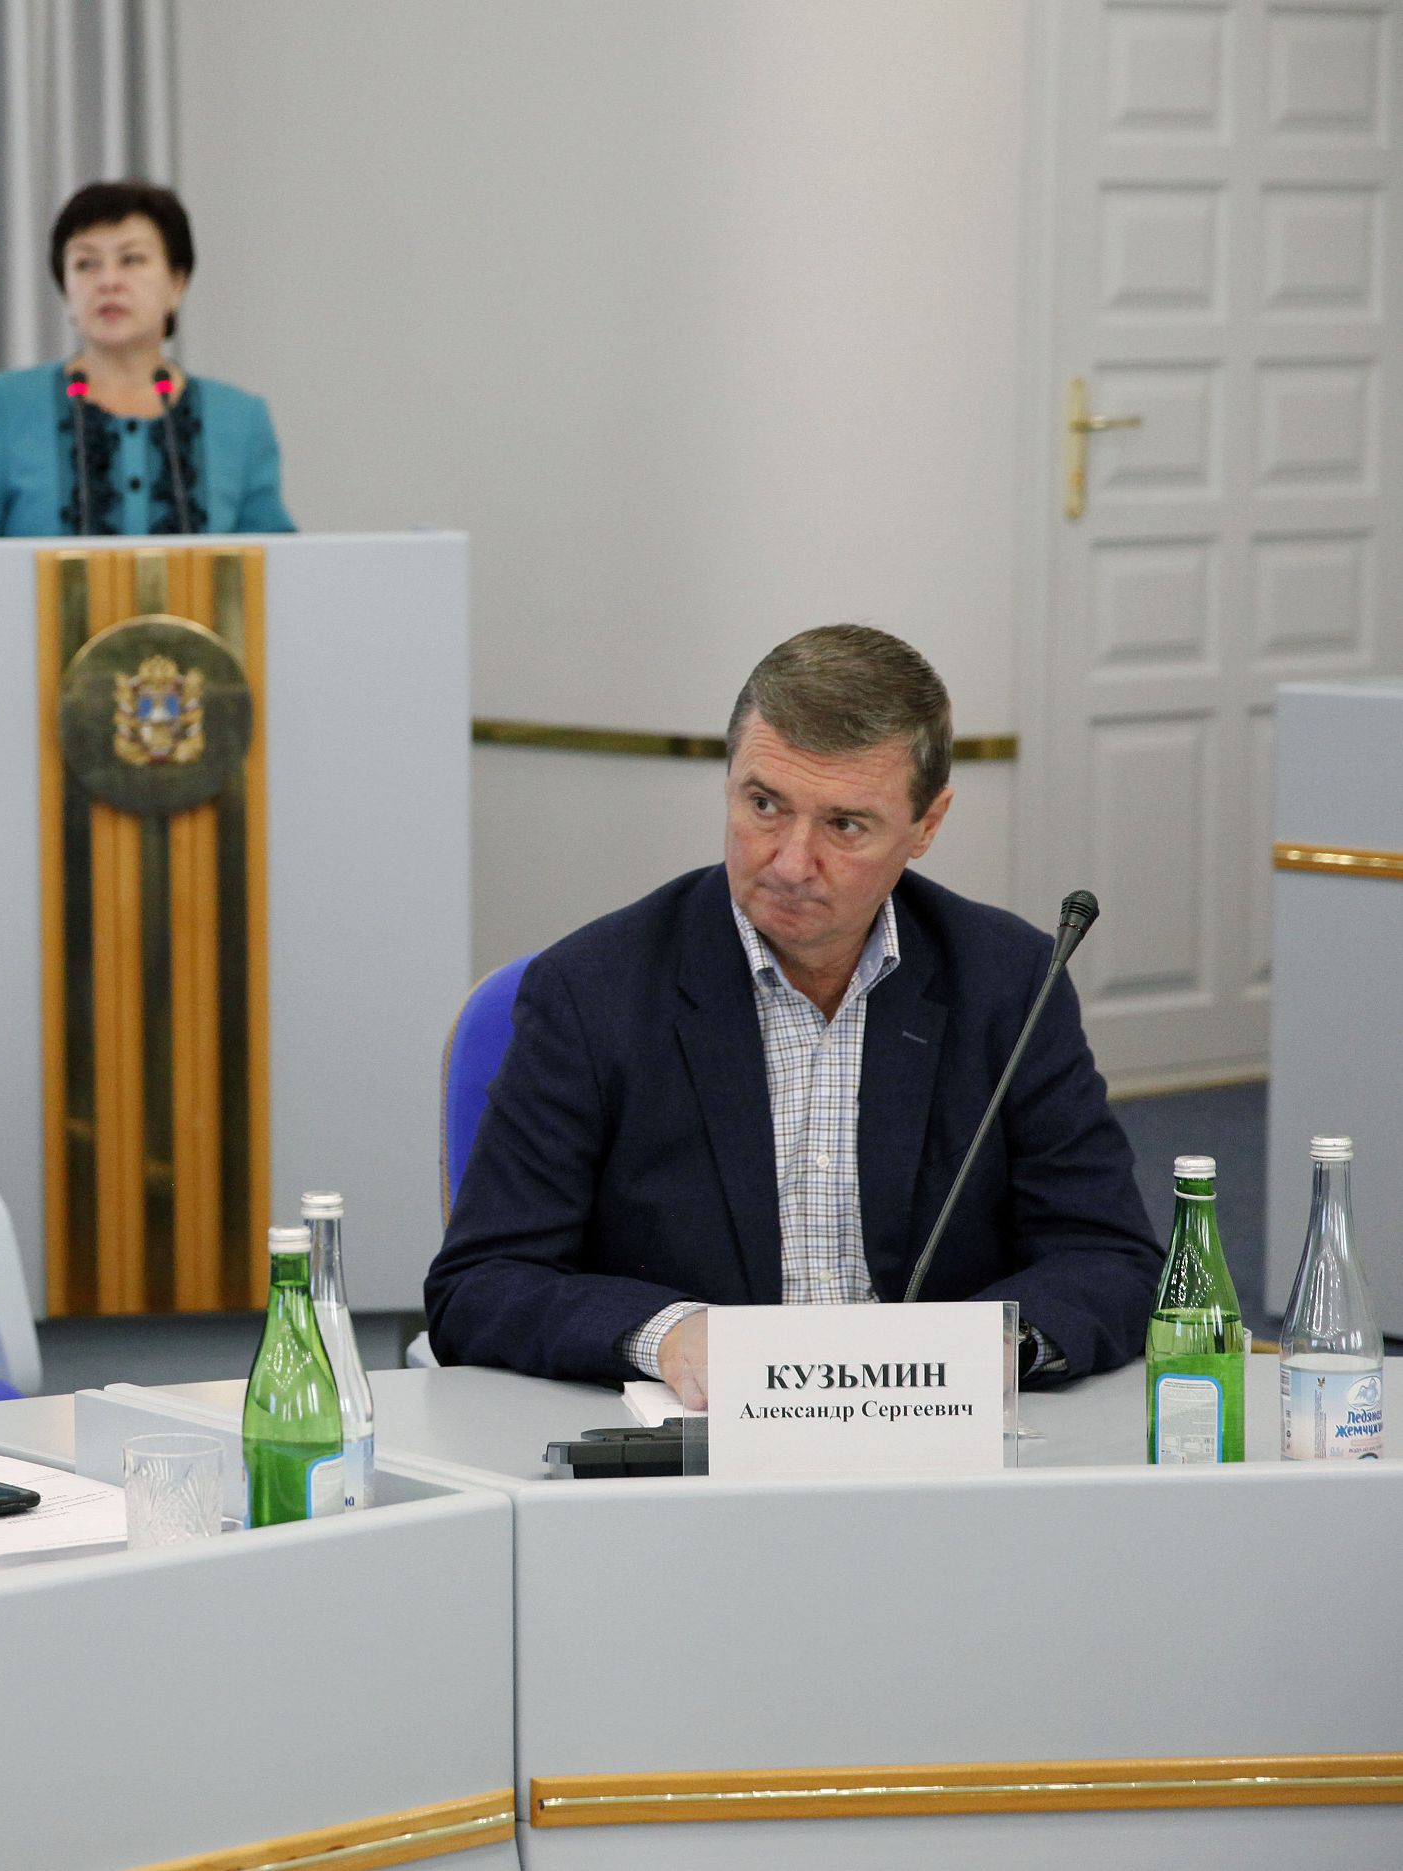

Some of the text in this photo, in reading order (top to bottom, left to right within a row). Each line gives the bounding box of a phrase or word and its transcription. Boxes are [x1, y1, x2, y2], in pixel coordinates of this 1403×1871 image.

[765, 1362, 948, 1390] КУЗЬМИН
[740, 1401, 973, 1422] Александр Сергеевич
